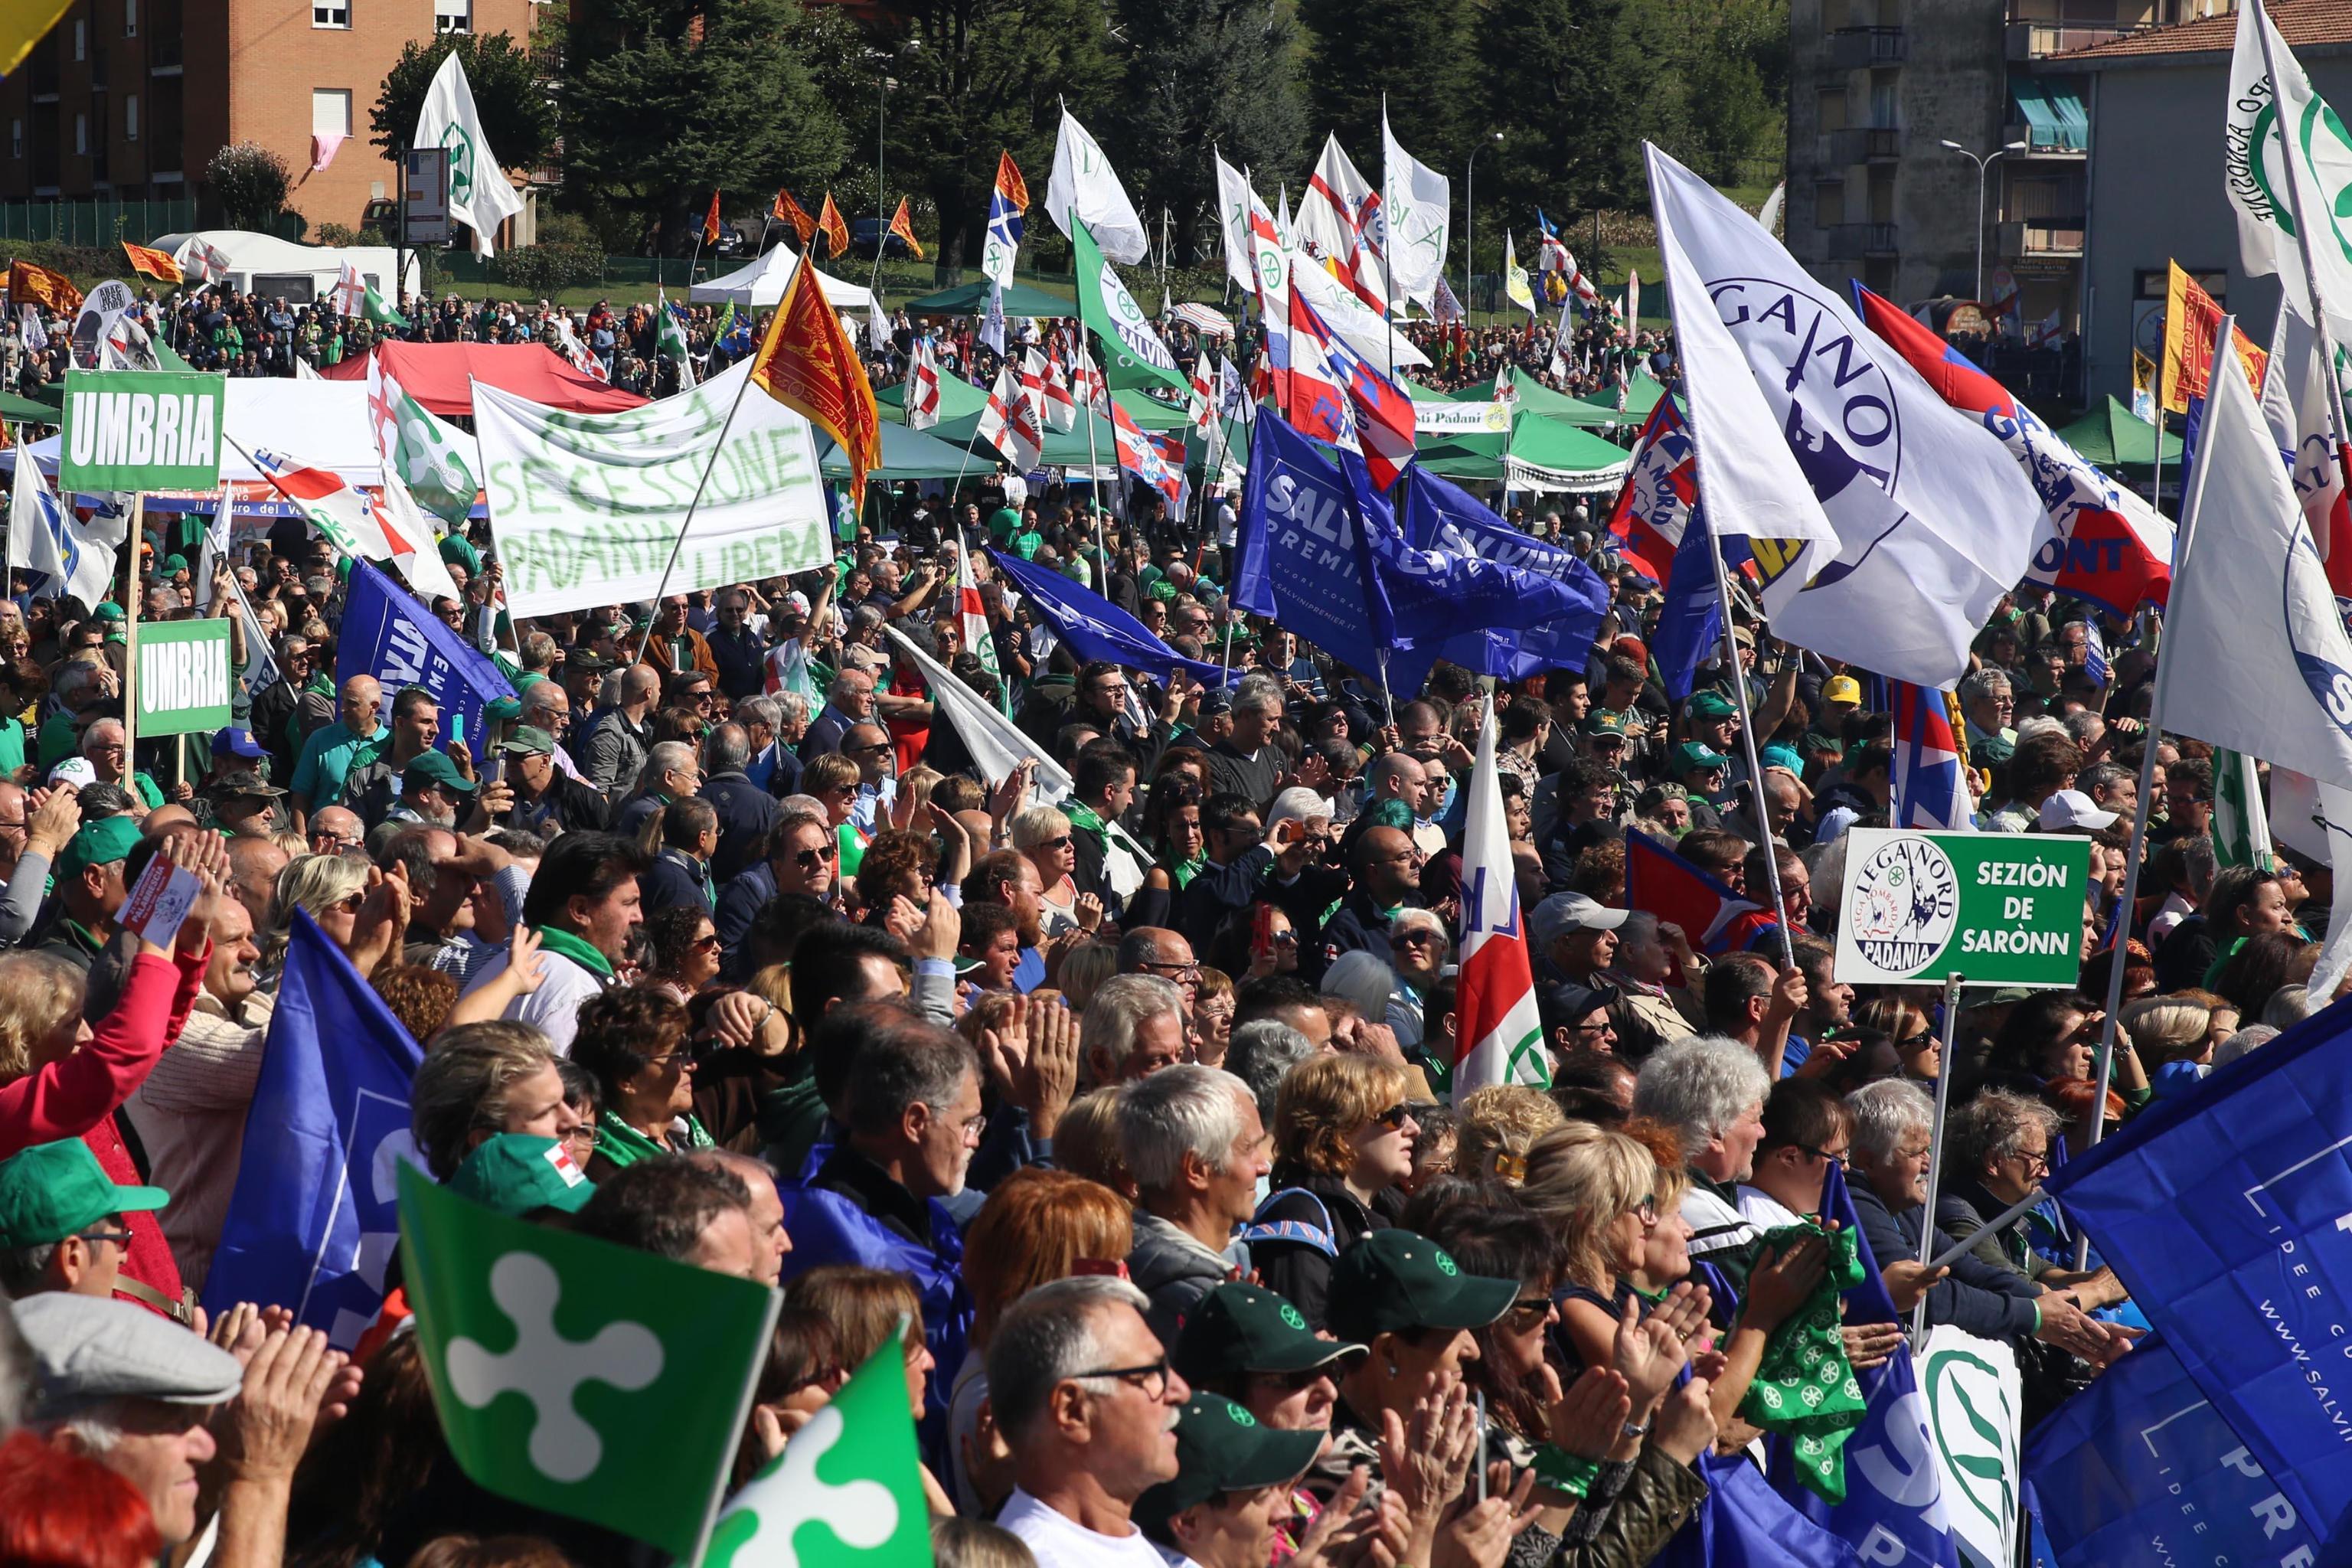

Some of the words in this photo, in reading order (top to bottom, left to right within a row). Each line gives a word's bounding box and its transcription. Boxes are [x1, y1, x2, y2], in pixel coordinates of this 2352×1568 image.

[70, 391, 214, 467] UMBRIA
[1435, 412, 1481, 424] Padani
[488, 426, 813, 517] SECESSIONE
[194, 501, 204, 511] il
[260, 501, 279, 514] del
[500, 519, 685, 594] PADANIA
[695, 518, 822, 590] LIBERA
[141, 641, 228, 713] UMBRIA
[1856, 842, 1908, 894] LEGA
[1914, 843, 1953, 920] NORD
[1976, 855, 2068, 888] SEZIÒN
[1866, 888, 1899, 929] LOMBARDA
[2003, 896, 2034, 920] DE
[1864, 942, 1930, 971] PADANIA
[1961, 923, 2069, 956] SARÒNN
[2269, 1225, 2322, 1299] IDEE
[2158, 1467, 2208, 1534] IDEE
